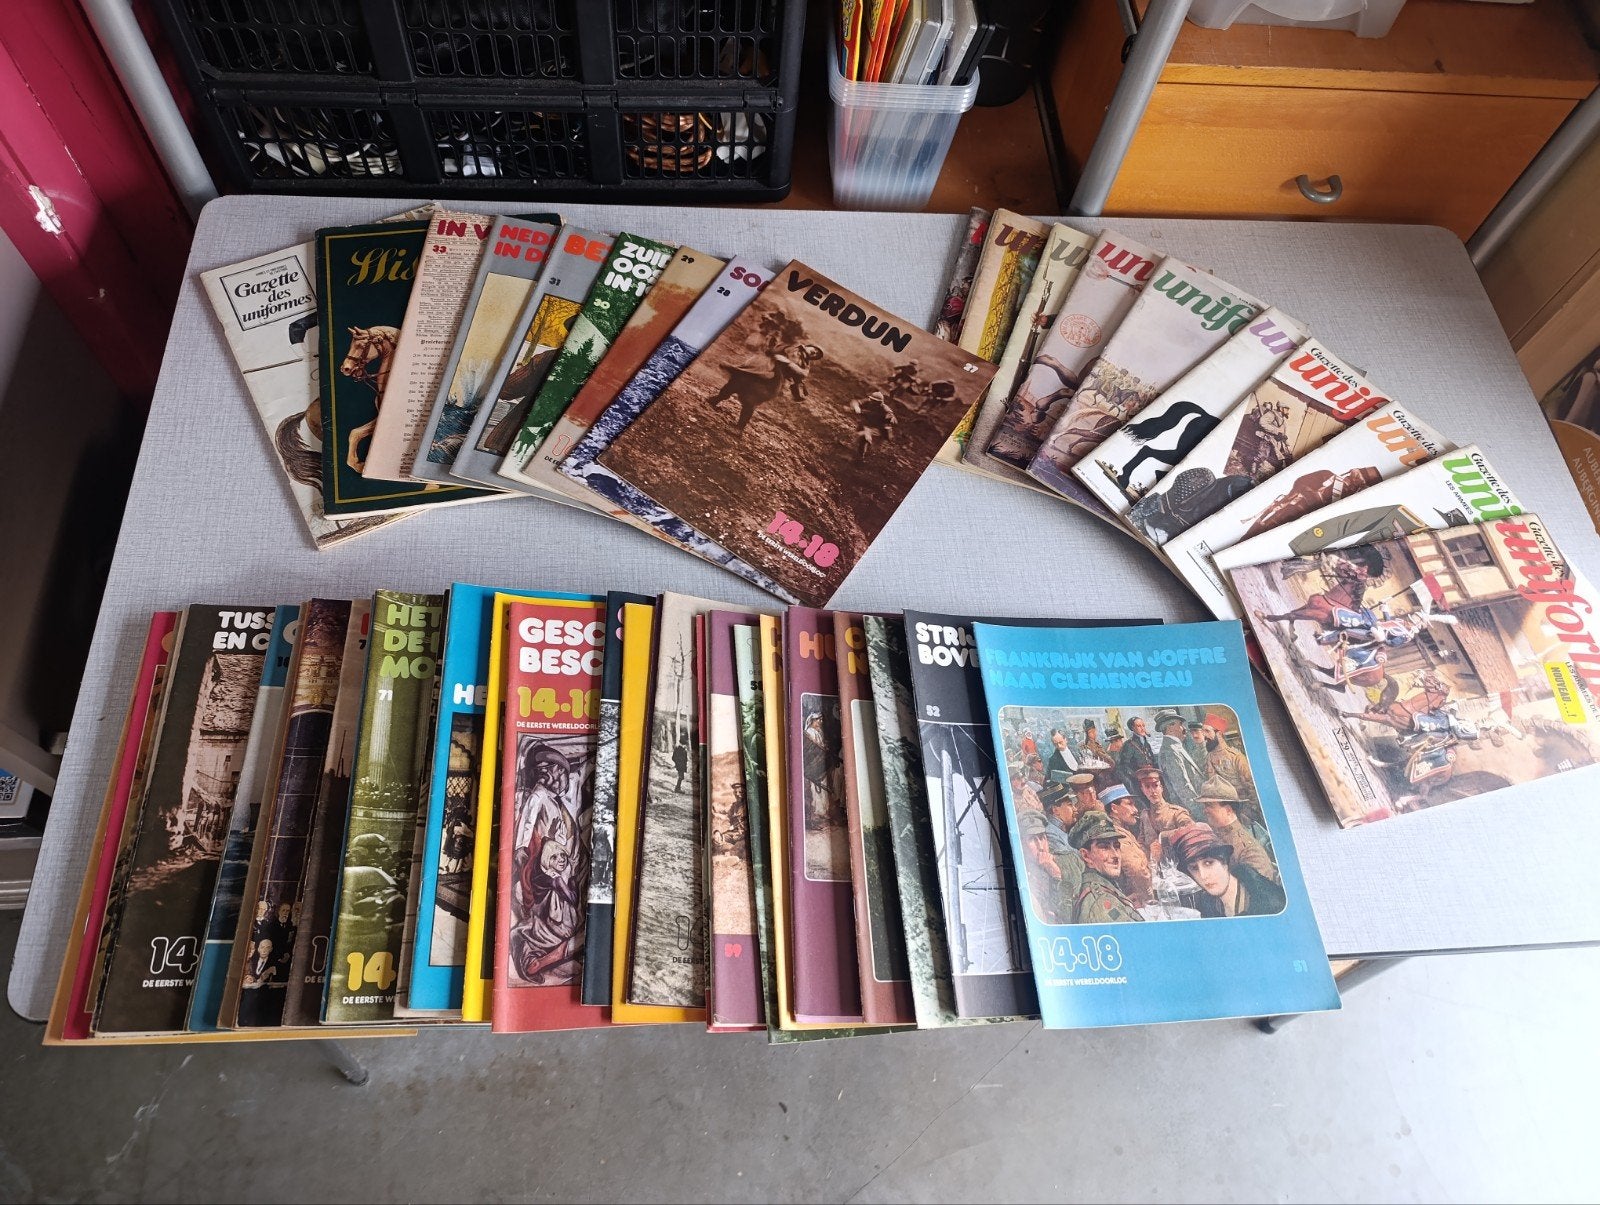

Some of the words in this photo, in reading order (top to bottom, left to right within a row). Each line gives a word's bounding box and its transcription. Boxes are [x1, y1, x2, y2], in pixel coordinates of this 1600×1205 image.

[436, 219, 466, 237] IN
[432, 245, 447, 253] 33
[493, 241, 521, 259] IN
[563, 234, 611, 262] BE
[681, 255, 695, 264] 29
[234, 271, 299, 298] Gazette
[548, 277, 561, 286] 31
[603, 272, 633, 293] IN
[716, 286, 731, 297] 28
[268, 289, 292, 303] des
[593, 298, 611, 309] 30
[241, 293, 313, 323] uniformes
[787, 270, 912, 353] VERDUN
[1310, 347, 1344, 376] Gazette
[1342, 374, 1359, 388] des
[1289, 352, 1391, 421] unif
[1393, 410, 1425, 443] Gazette
[1422, 438, 1439, 457] des
[1471, 452, 1499, 490] Gazette
[1496, 487, 1512, 505] des
[1442, 454, 1522, 525] uni
[1529, 521, 1556, 560] Gazette
[386, 603, 441, 628] HET
[213, 632, 247, 650] EN
[383, 629, 425, 653] DE
[984, 648, 1098, 669] FRANKRIJK
[1099, 651, 1145, 668] VAN
[1149, 646, 1227, 667] JOFFRE
[989, 670, 1047, 690] NAAR
[1050, 670, 1193, 690] CLEMENCEAU
[378, 690, 393, 700] 71
[926, 705, 940, 717] 52
[527, 721, 551, 729] EERSTE
[150, 937, 200, 974] 14
[347, 952, 397, 991] 14
[1075, 976, 1127, 985] WERELDOORLOG
[342, 996, 354, 1004] DE
[354, 995, 384, 1004] EERSTE
